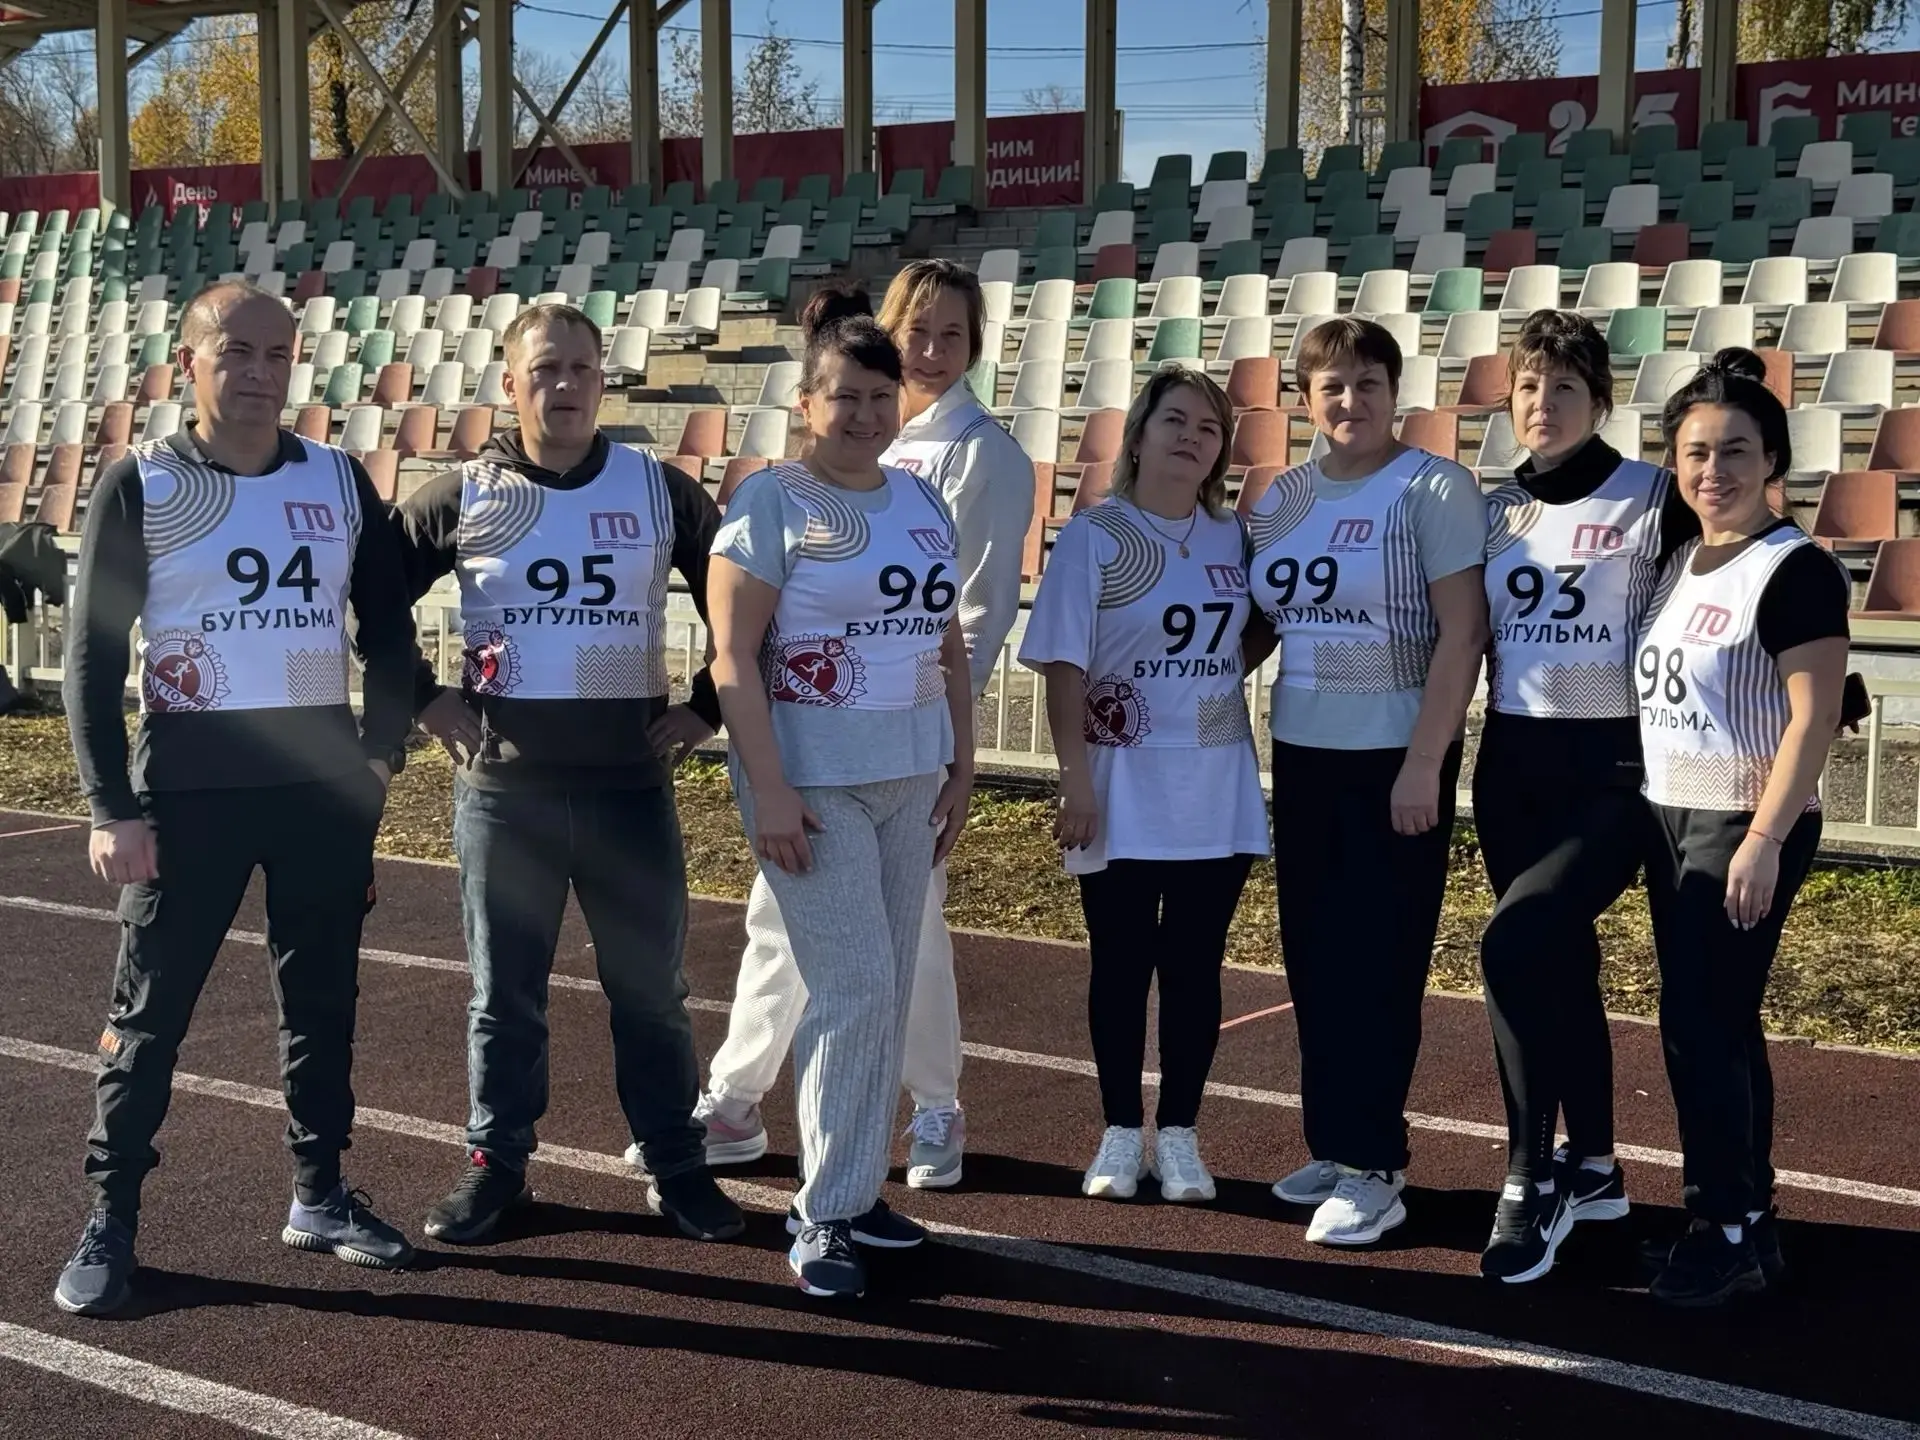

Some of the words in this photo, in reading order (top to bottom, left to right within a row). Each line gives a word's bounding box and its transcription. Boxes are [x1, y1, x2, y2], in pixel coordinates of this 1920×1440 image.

[1837, 80, 1920, 106] Мин
[985, 139, 1034, 159] НИМ
[985, 160, 1080, 189] ДИЦИИ!
[173, 182, 217, 205] День
[284, 501, 335, 532] ГТО
[589, 512, 640, 539] ГТО
[907, 529, 950, 551] ГТО
[1330, 519, 1374, 543] ГТО
[1572, 524, 1624, 550] ГТО
[226, 545, 320, 606] 94
[526, 554, 616, 606] 95
[879, 562, 956, 615] 96
[1204, 565, 1245, 588] ГТО
[1265, 556, 1338, 606] 99
[1507, 564, 1586, 620] 93
[202, 608, 336, 633] БУГУЛЬМА
[502, 607, 639, 626] БУГУЛЬМА
[846, 617, 950, 637] БУГУЛЬМ
[1162, 602, 1234, 655] 97
[1685, 603, 1732, 636] ГТО
[788, 674, 812, 695] ГТО
[1639, 645, 1687, 705] 98
[157, 681, 181, 702] ГТО
[1641, 706, 1717, 732] ГУЛЬМА
